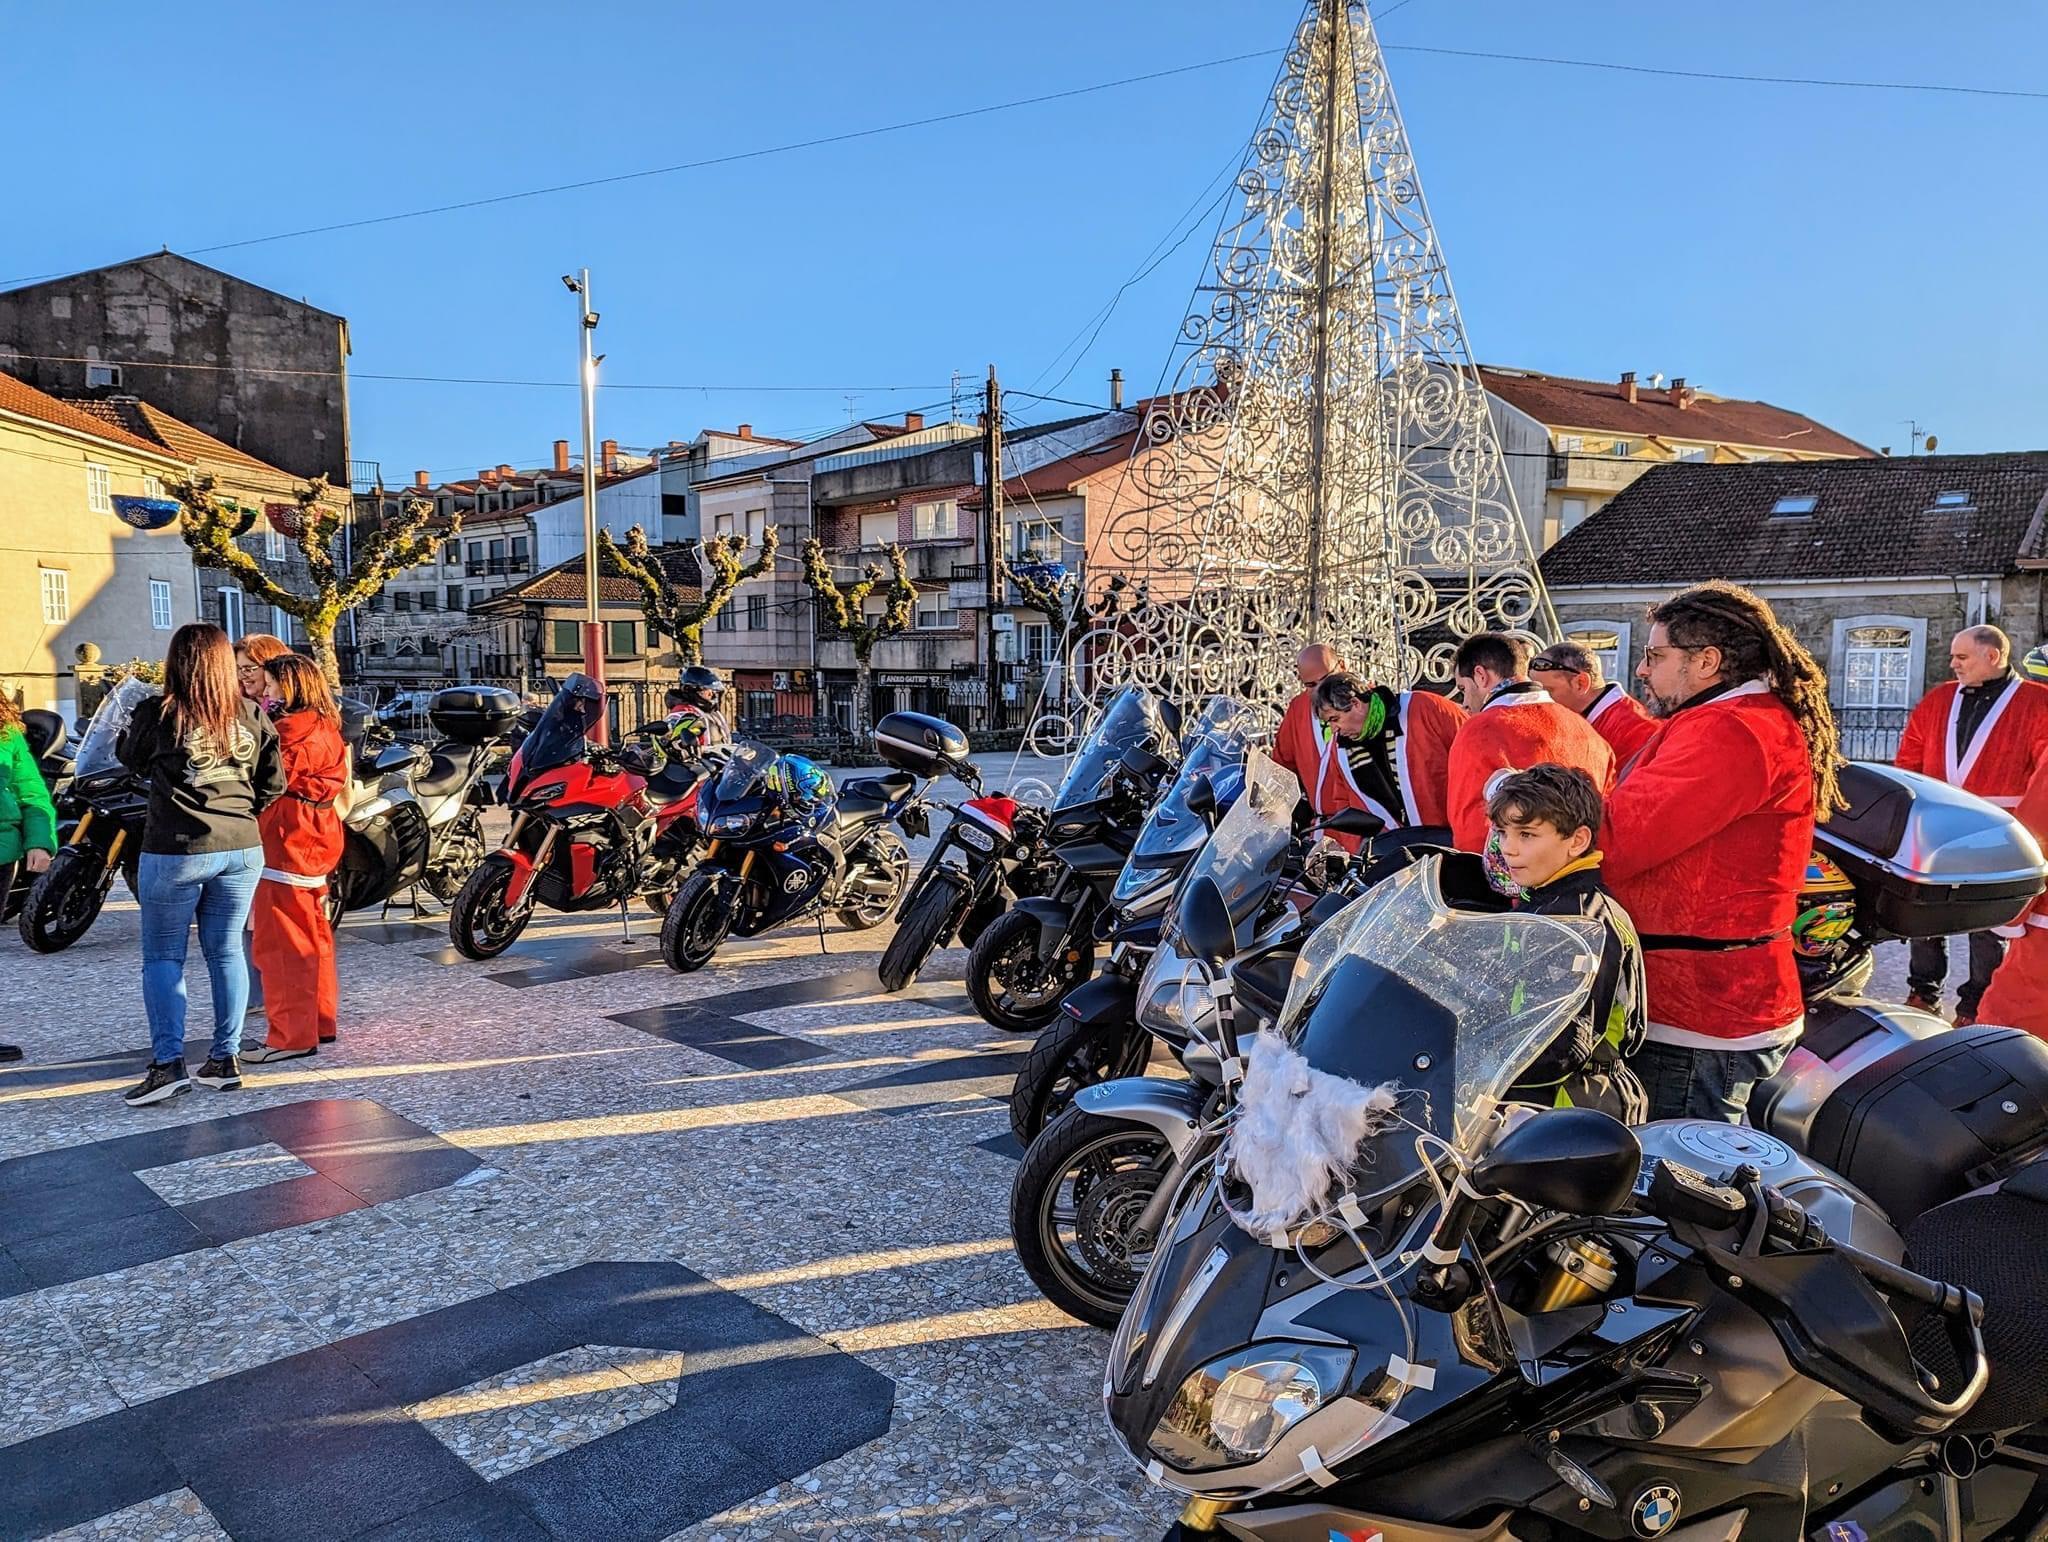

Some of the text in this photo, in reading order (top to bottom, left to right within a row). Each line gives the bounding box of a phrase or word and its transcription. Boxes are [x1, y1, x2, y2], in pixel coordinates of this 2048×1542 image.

[886, 675, 940, 684] ANXO GUTIEREZ
[1637, 1489, 1677, 1512] BMW
